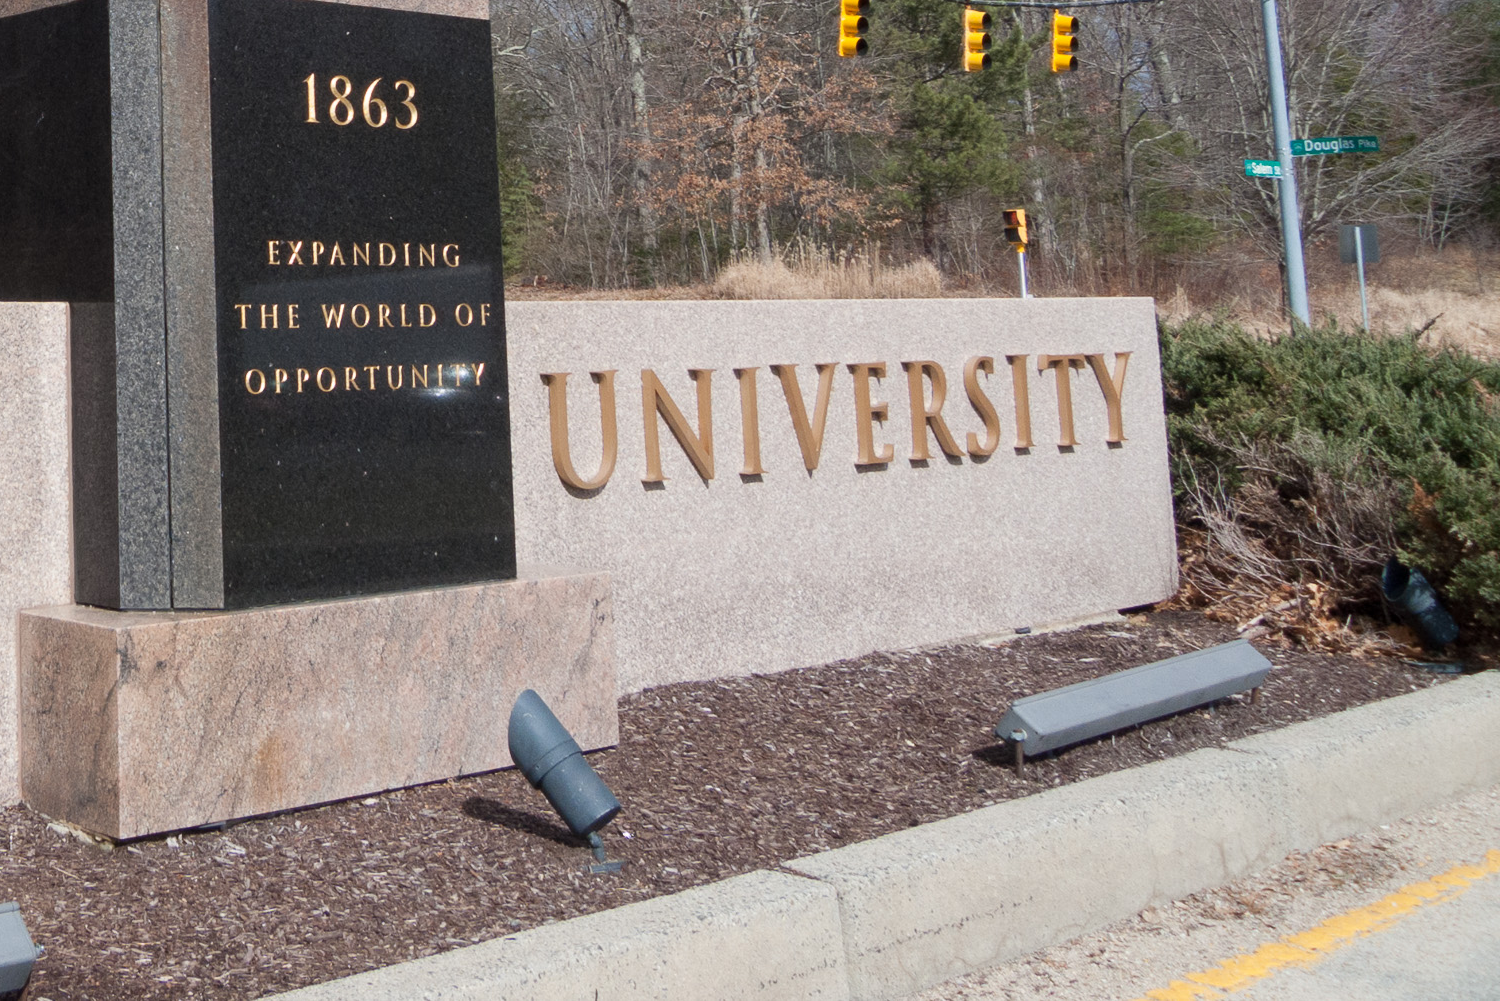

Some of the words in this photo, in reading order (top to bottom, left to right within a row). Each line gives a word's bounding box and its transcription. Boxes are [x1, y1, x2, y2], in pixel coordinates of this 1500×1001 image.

[302, 72, 419, 130] 1863
[1303, 138, 1355, 153] Douglas
[1358, 139, 1377, 148] Pike
[1251, 162, 1273, 174] Salem
[267, 239, 461, 268] EXPANDING
[234, 303, 300, 330] THE
[321, 302, 437, 329] WORLD
[454, 302, 491, 327] OF
[244, 362, 485, 395] OPPORTUNITY
[538, 350, 1134, 491] UNIVERSITY
